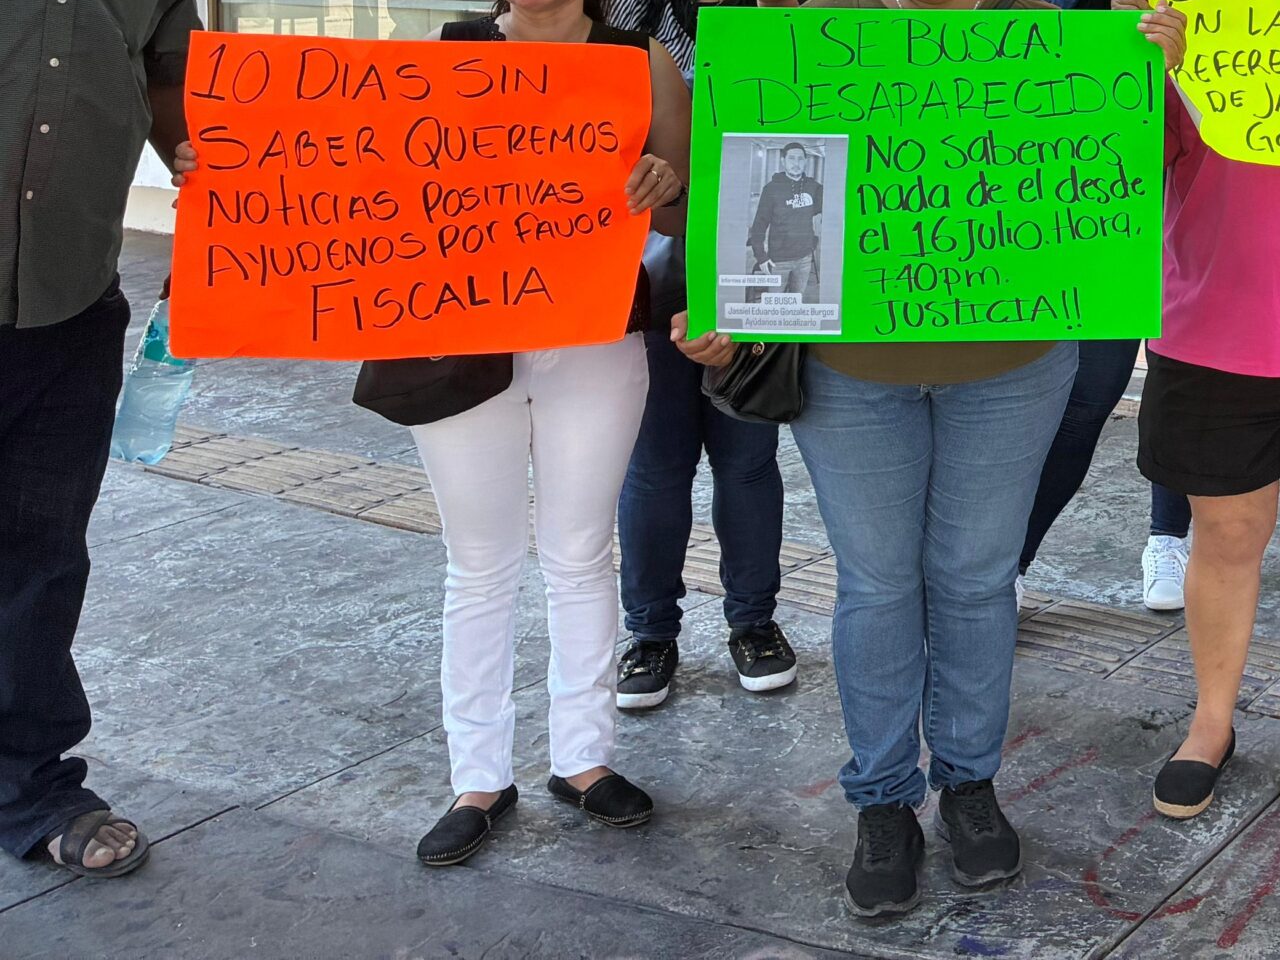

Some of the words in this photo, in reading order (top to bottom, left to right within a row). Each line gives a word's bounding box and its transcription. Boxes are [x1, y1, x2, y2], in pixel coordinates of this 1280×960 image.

[890, 11, 1065, 67] BUSCA!
[190, 42, 271, 104] 10
[295, 47, 432, 101] DIAS
[451, 58, 550, 99] SIN
[1205, 88, 1246, 114] DE
[199, 124, 386, 172] SABER
[403, 115, 620, 171] QUEREMOS
[421, 178, 586, 225] POSITIVAS
[856, 174, 951, 216] nada
[965, 170, 1008, 208] de
[1017, 167, 1044, 203] el
[1054, 164, 1147, 205] desde
[206, 229, 428, 288] AYUDENOS
[858, 221, 890, 255] el
[899, 215, 958, 258] 16
[310, 266, 555, 343] FISCALIA
[751, 306, 779, 316] Eduardo
[810, 307, 835, 318] Burgos
[764, 296, 773, 305] SE
[774, 296, 798, 306] BUSCA
